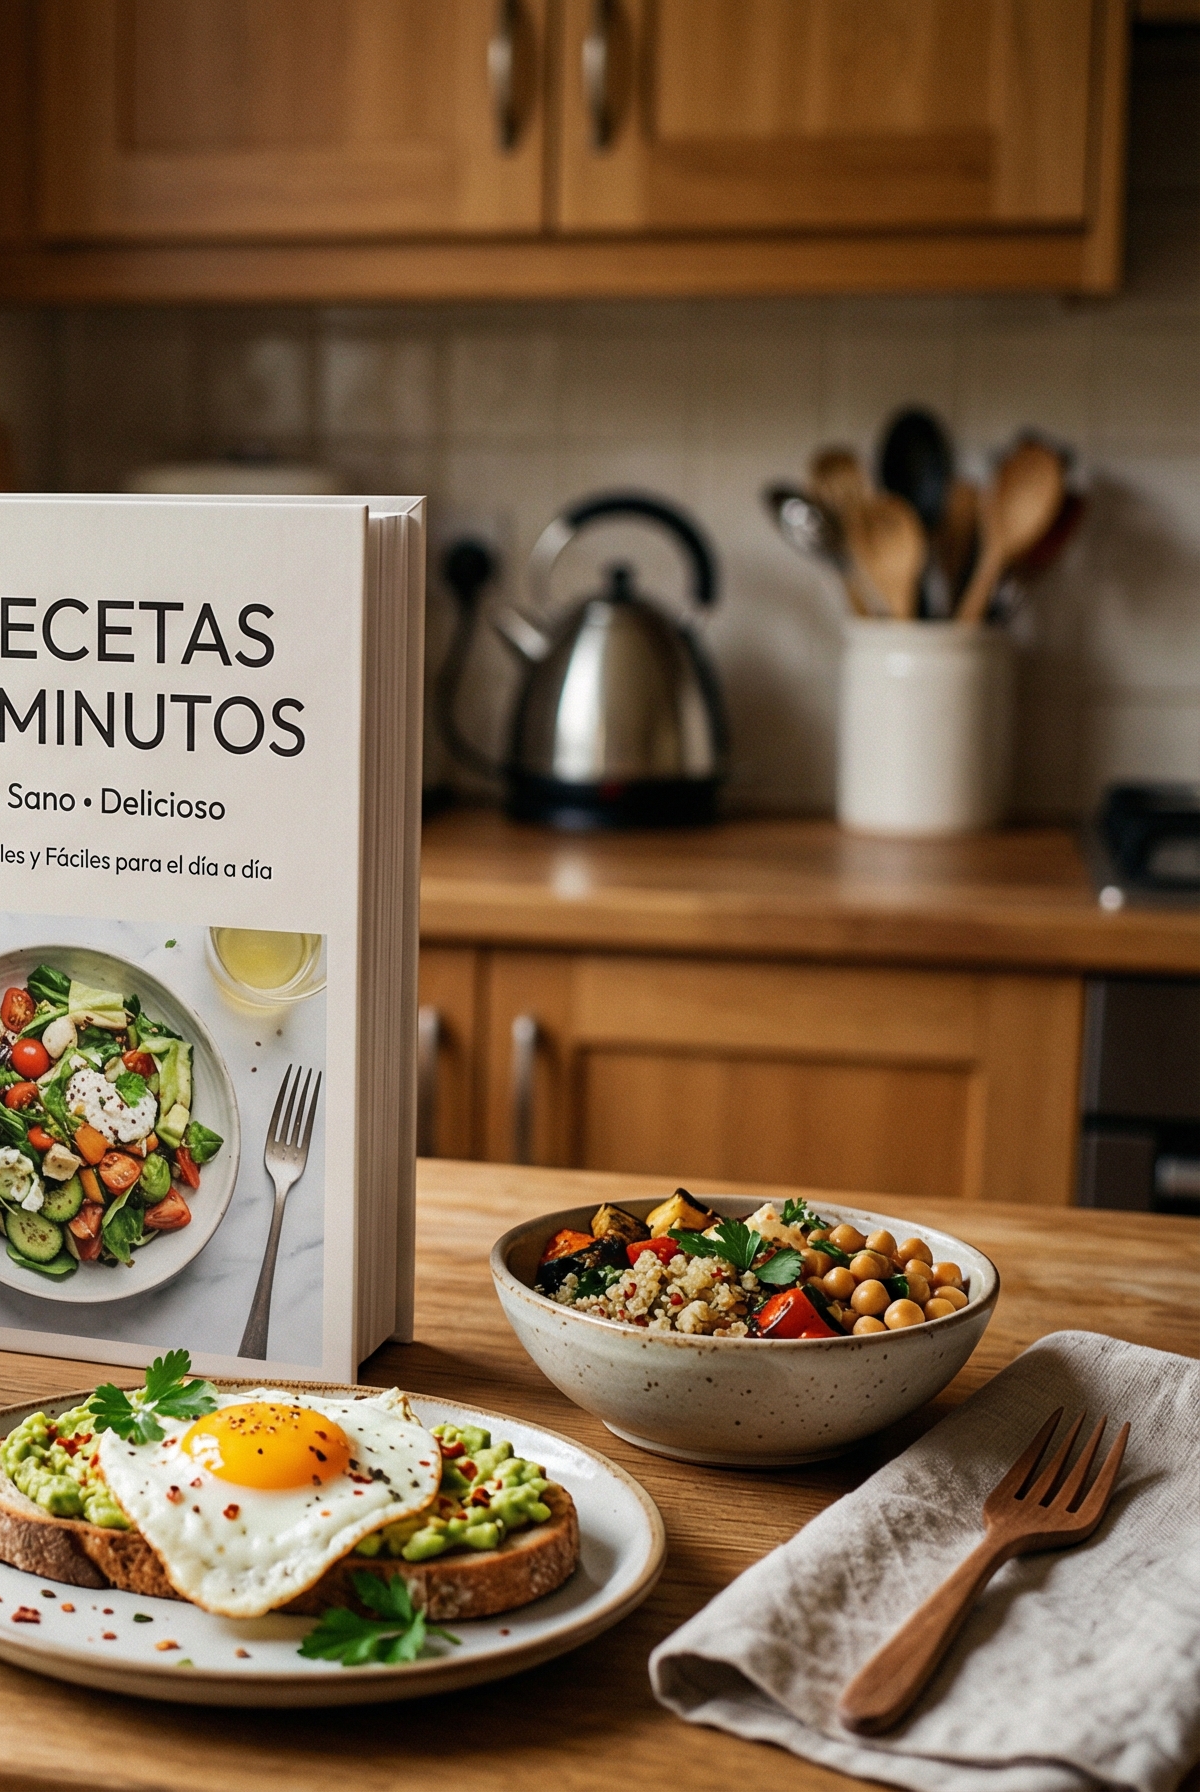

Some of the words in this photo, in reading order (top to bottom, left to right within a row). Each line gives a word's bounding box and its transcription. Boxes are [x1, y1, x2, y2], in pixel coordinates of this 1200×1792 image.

[7, 782, 76, 812] Sano
[101, 787, 226, 821] Delicioso
[29, 850, 41, 871] y
[46, 846, 111, 870] Fáciles
[115, 856, 162, 876] para
[166, 854, 183, 875] el
[188, 855, 219, 877] día
[223, 863, 236, 878] a
[241, 858, 273, 880] día
